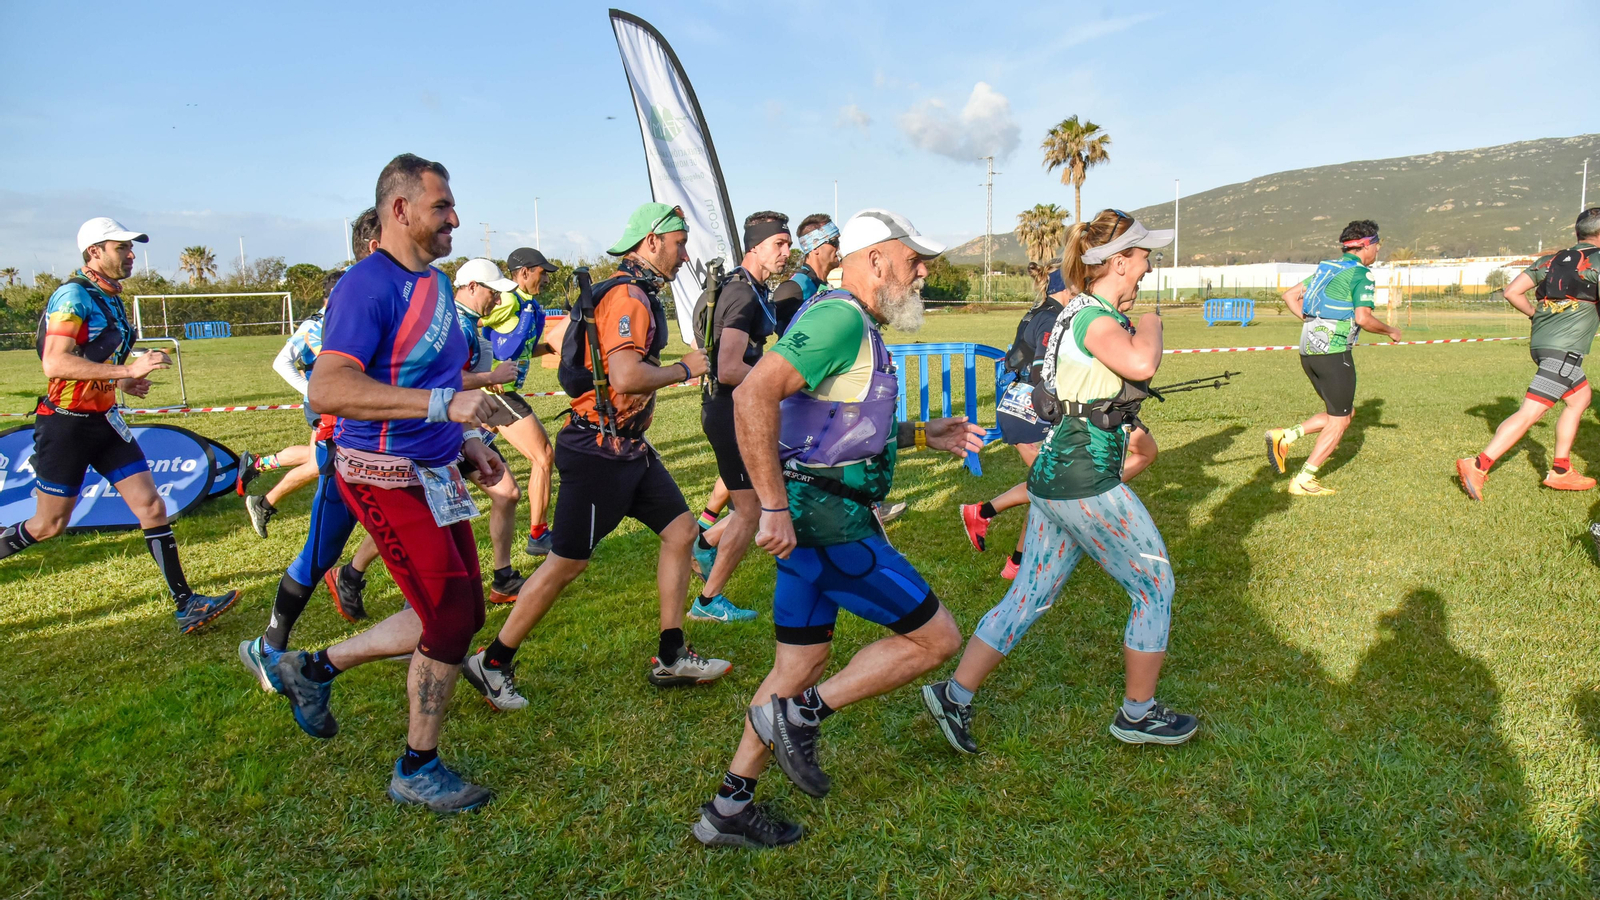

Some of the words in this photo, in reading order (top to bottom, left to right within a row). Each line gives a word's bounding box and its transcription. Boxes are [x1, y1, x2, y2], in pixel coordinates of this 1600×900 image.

[433, 309, 454, 353] RUNNERS
[1012, 390, 1032, 406] 146
[356, 484, 407, 563] WONG
[776, 712, 794, 757] MERRELL
